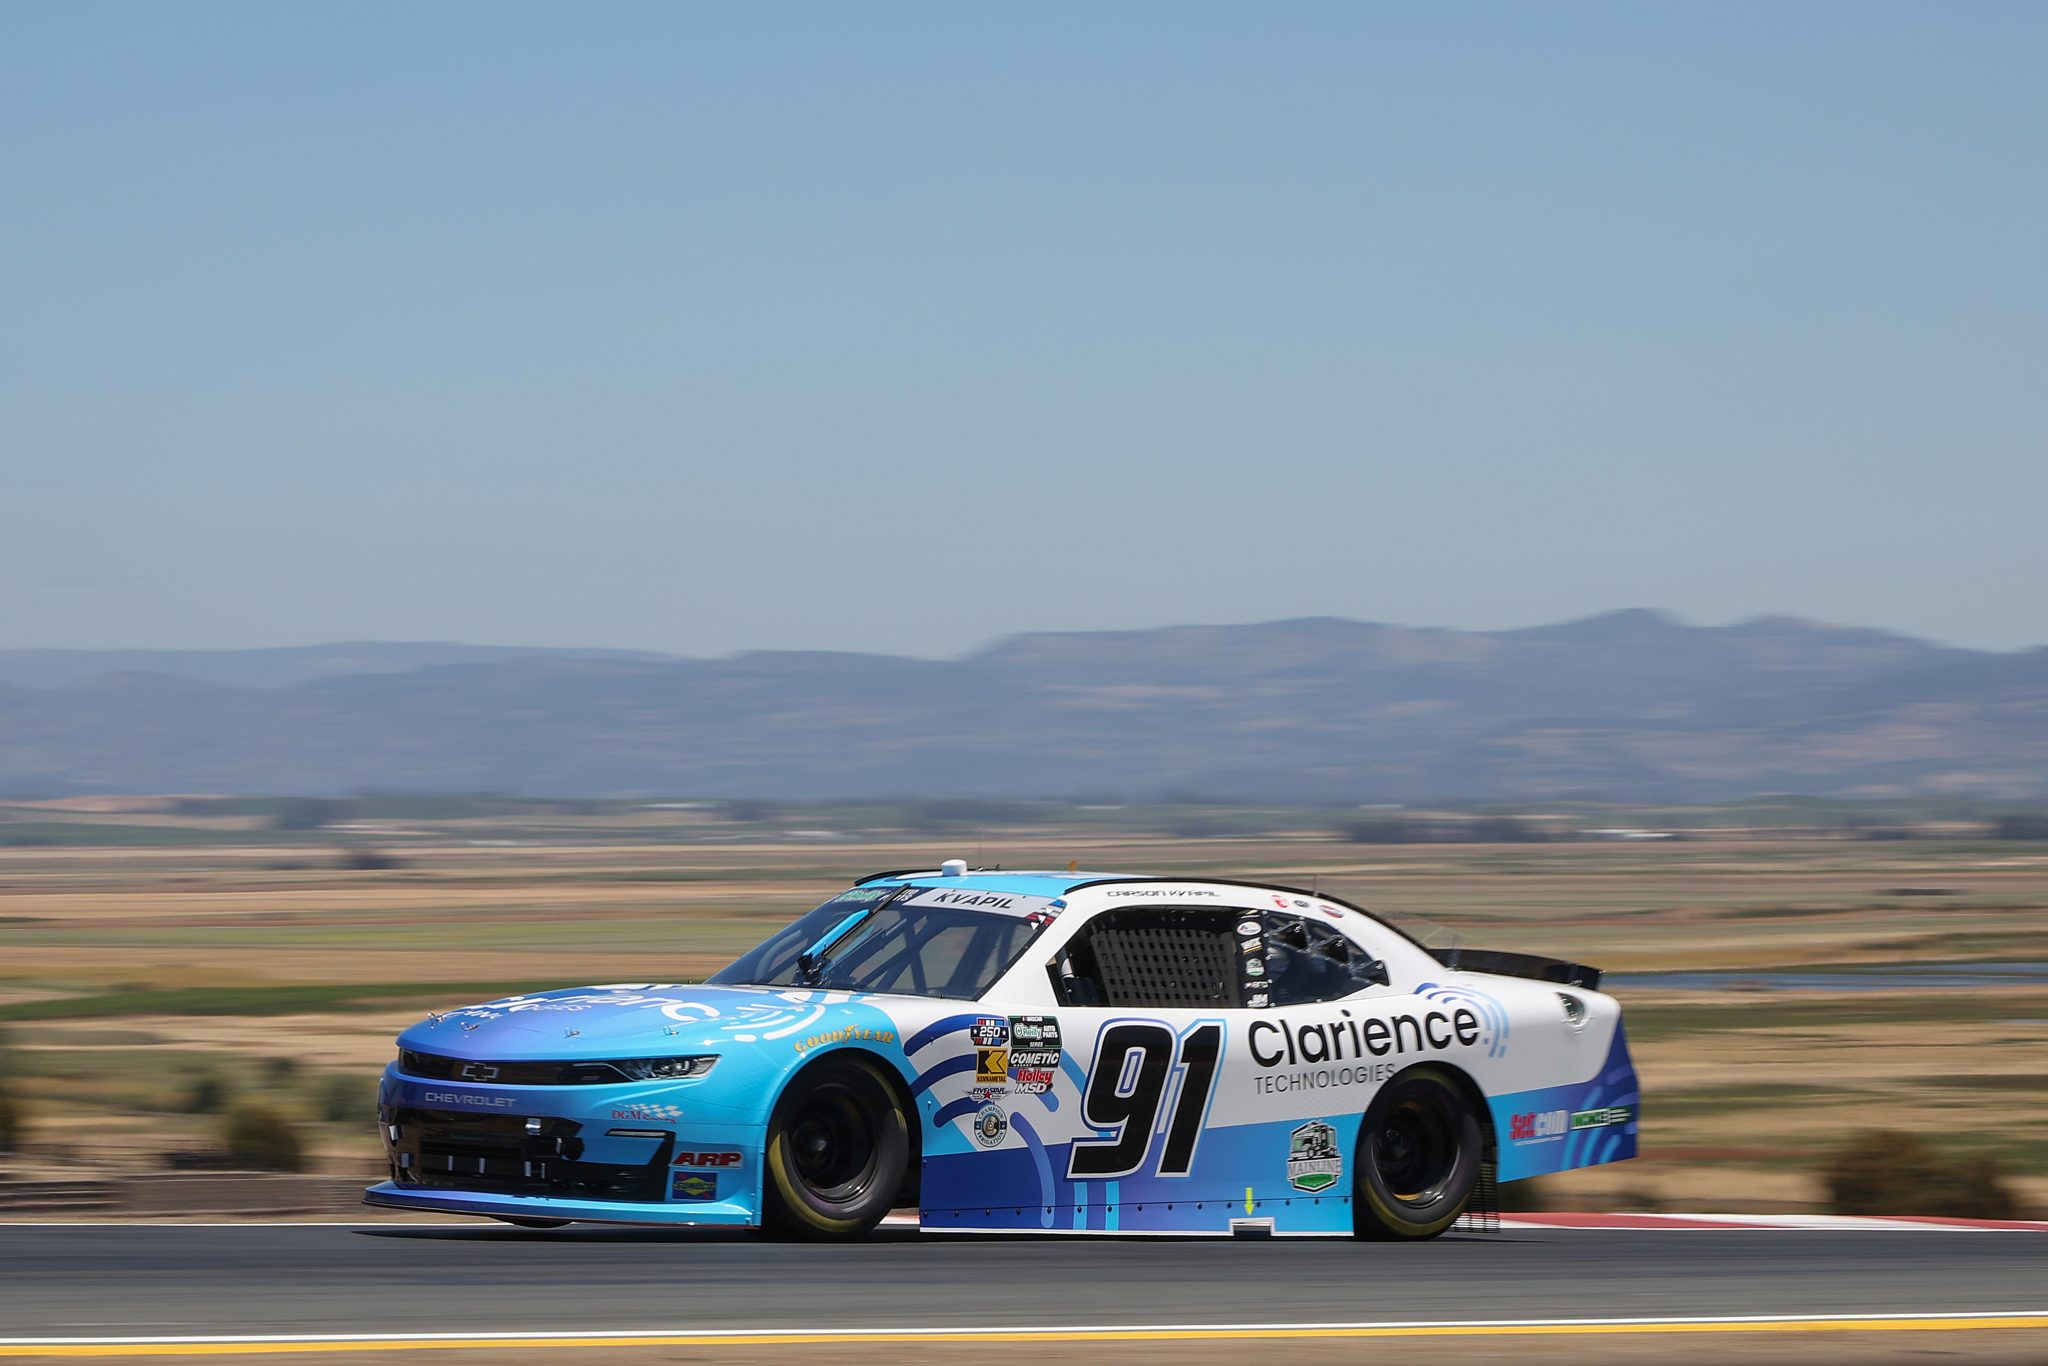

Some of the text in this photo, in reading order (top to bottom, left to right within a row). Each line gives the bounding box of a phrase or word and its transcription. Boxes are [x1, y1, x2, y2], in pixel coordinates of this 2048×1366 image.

[933, 892, 1013, 909] KVAPIL
[794, 1025, 894, 1053] GOODYEAR
[979, 1026, 1001, 1037] 250
[1248, 1008, 1480, 1068] Clarience
[1010, 1052, 1060, 1065] COMETIC
[1017, 1067, 1055, 1084] Holley
[1254, 1063, 1396, 1095] TECHNOLOGIES
[1014, 1082, 1048, 1094] MSD
[425, 1092, 517, 1108] CHEVROLET
[1067, 1019, 1226, 1178] 91
[611, 1110, 641, 1120] DGM
[978, 1105, 1004, 1119] CHAMPION
[671, 1152, 742, 1167] ARP
[1287, 1158, 1342, 1180] MAINLINE
